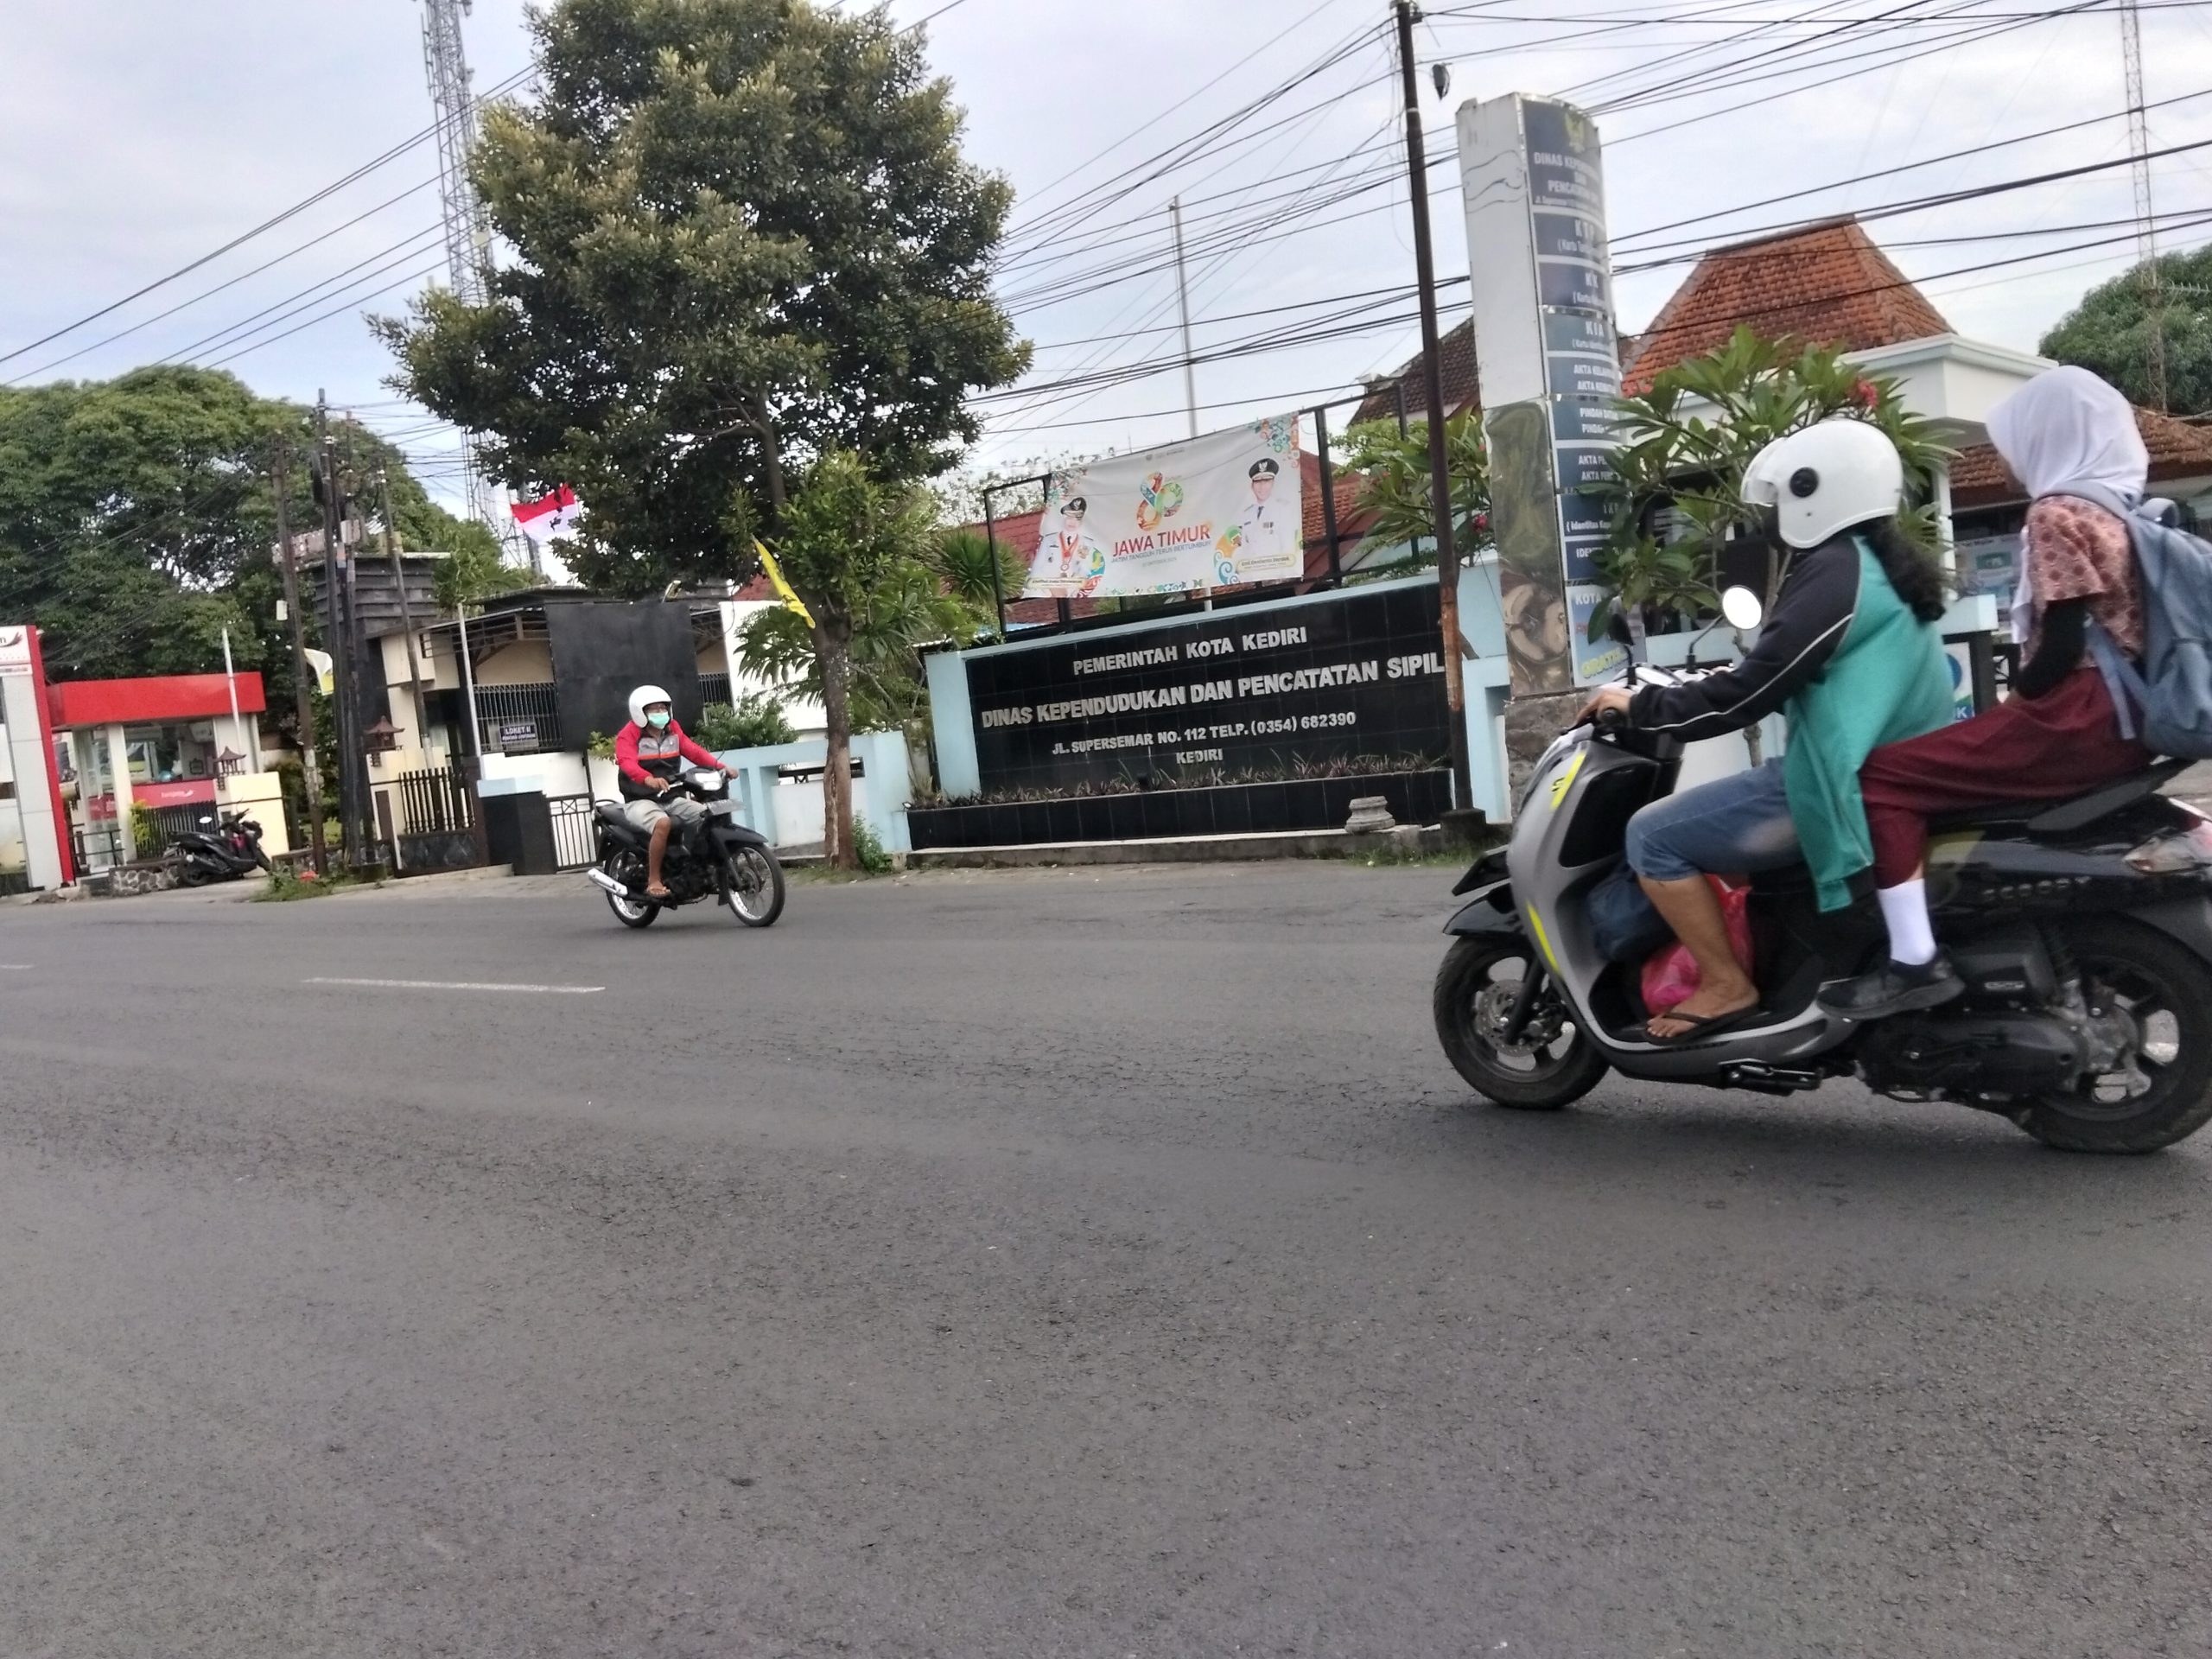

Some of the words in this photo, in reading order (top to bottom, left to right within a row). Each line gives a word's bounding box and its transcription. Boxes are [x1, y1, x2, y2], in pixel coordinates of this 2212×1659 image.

[1113, 535, 1154, 557] JAWA
[1157, 524, 1211, 548] TIMUR
[1072, 645, 1179, 676] PEMERINTAH
[1186, 637, 1234, 659] KOTA
[1243, 626, 1307, 652] KEDIRI
[982, 706, 1033, 728] DINAS
[1037, 685, 1186, 722] KEPENDUDUKAN
[1191, 679, 1233, 703] DAN
[1238, 660, 1379, 697] PENCATATAN
[1387, 652, 1446, 678] SIPIL
[1052, 742, 1070, 755] JL.
[1071, 733, 1154, 753] SUPERSEMAR
[1158, 730, 1182, 745] NO.
[1184, 727, 1207, 741] 112
[1210, 723, 1249, 738] TELP.
[1251, 715, 1297, 735] (0354)
[1300, 711, 1357, 729] 682390
[1176, 748, 1224, 765] KEDIRI
